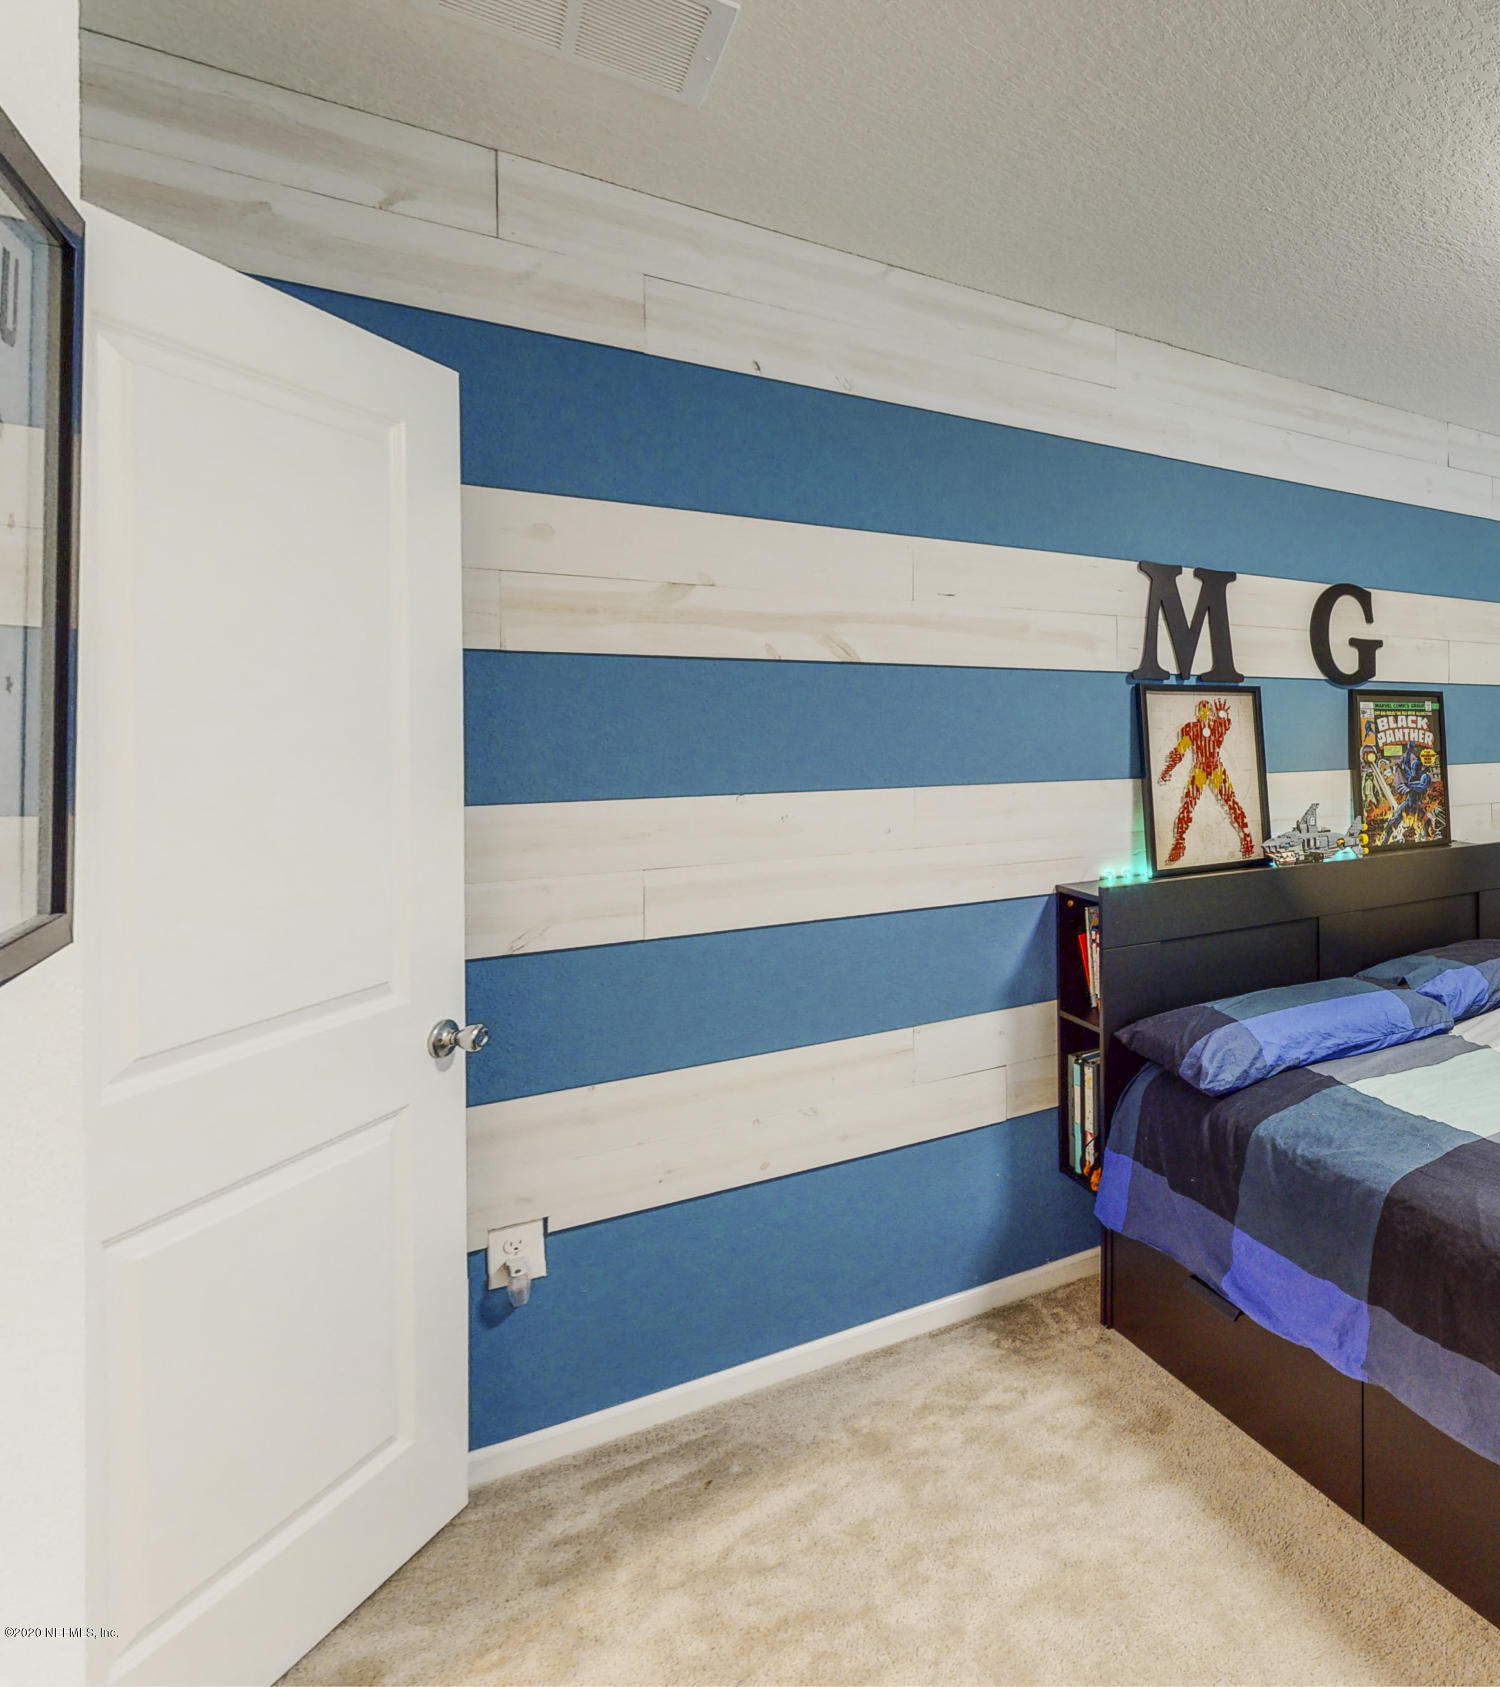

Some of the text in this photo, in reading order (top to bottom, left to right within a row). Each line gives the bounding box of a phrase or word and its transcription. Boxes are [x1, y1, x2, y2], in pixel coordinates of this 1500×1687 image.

[1132, 560, 1383, 686] M G
[1376, 715, 1429, 731] BLACK
[1377, 728, 1434, 747] PANTHER
